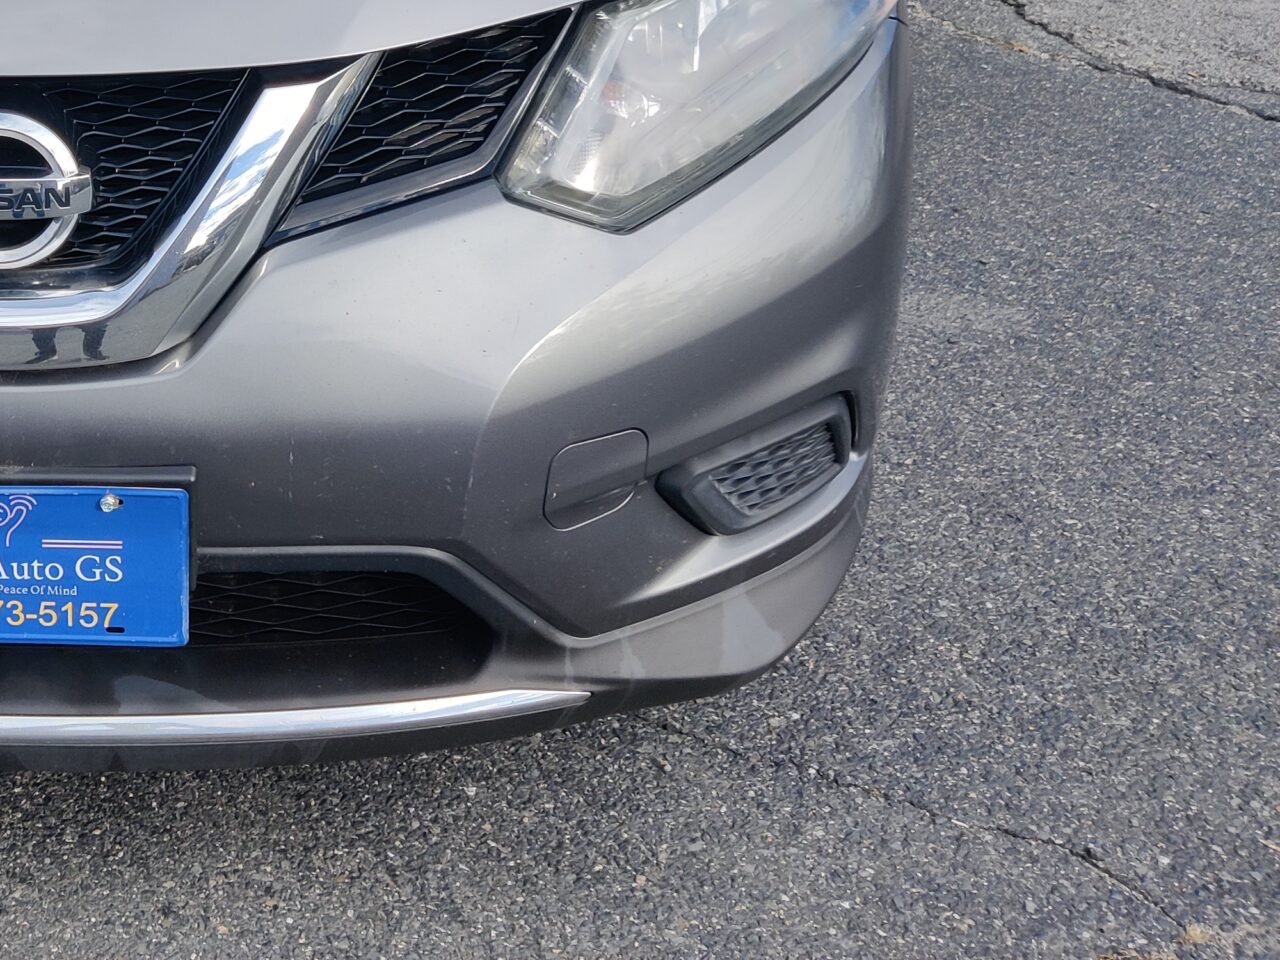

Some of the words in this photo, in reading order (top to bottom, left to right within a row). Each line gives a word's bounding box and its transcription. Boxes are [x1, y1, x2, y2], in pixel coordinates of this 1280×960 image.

[75, 555, 123, 582] GS
[30, 586, 46, 595] Of
[47, 586, 78, 596] Mind
